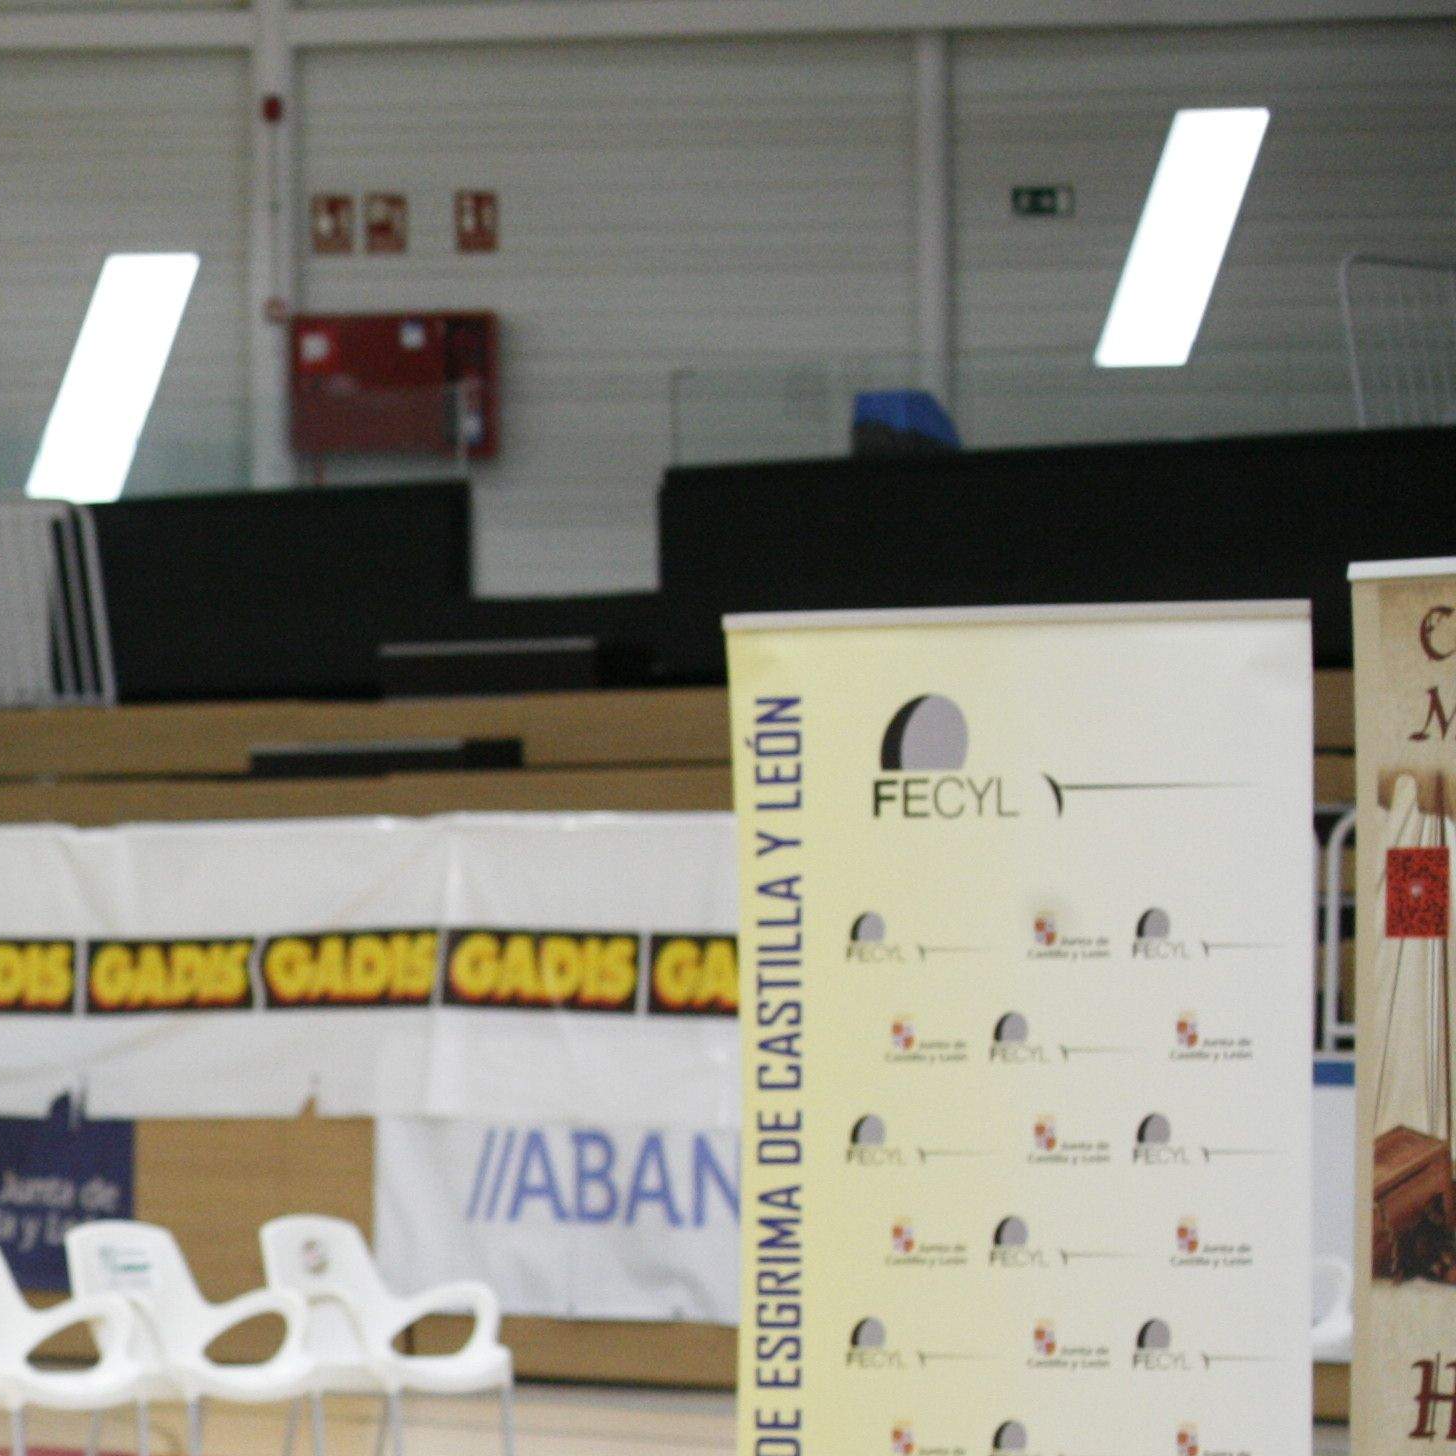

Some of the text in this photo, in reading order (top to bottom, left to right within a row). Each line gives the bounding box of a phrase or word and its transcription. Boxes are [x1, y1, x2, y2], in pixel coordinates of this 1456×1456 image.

[745, 697, 802, 811] LEÓN
[872, 776, 1019, 818] FECYL
[755, 831, 802, 857] Y
[90, 939, 254, 1009] GADIS
[265, 929, 439, 1003] GADIS
[449, 933, 639, 1005] GADIS
[755, 875, 802, 1090] CASTILLA
[757, 1110, 802, 1165] DE
[756, 1184, 802, 1388] ESGRIMA
